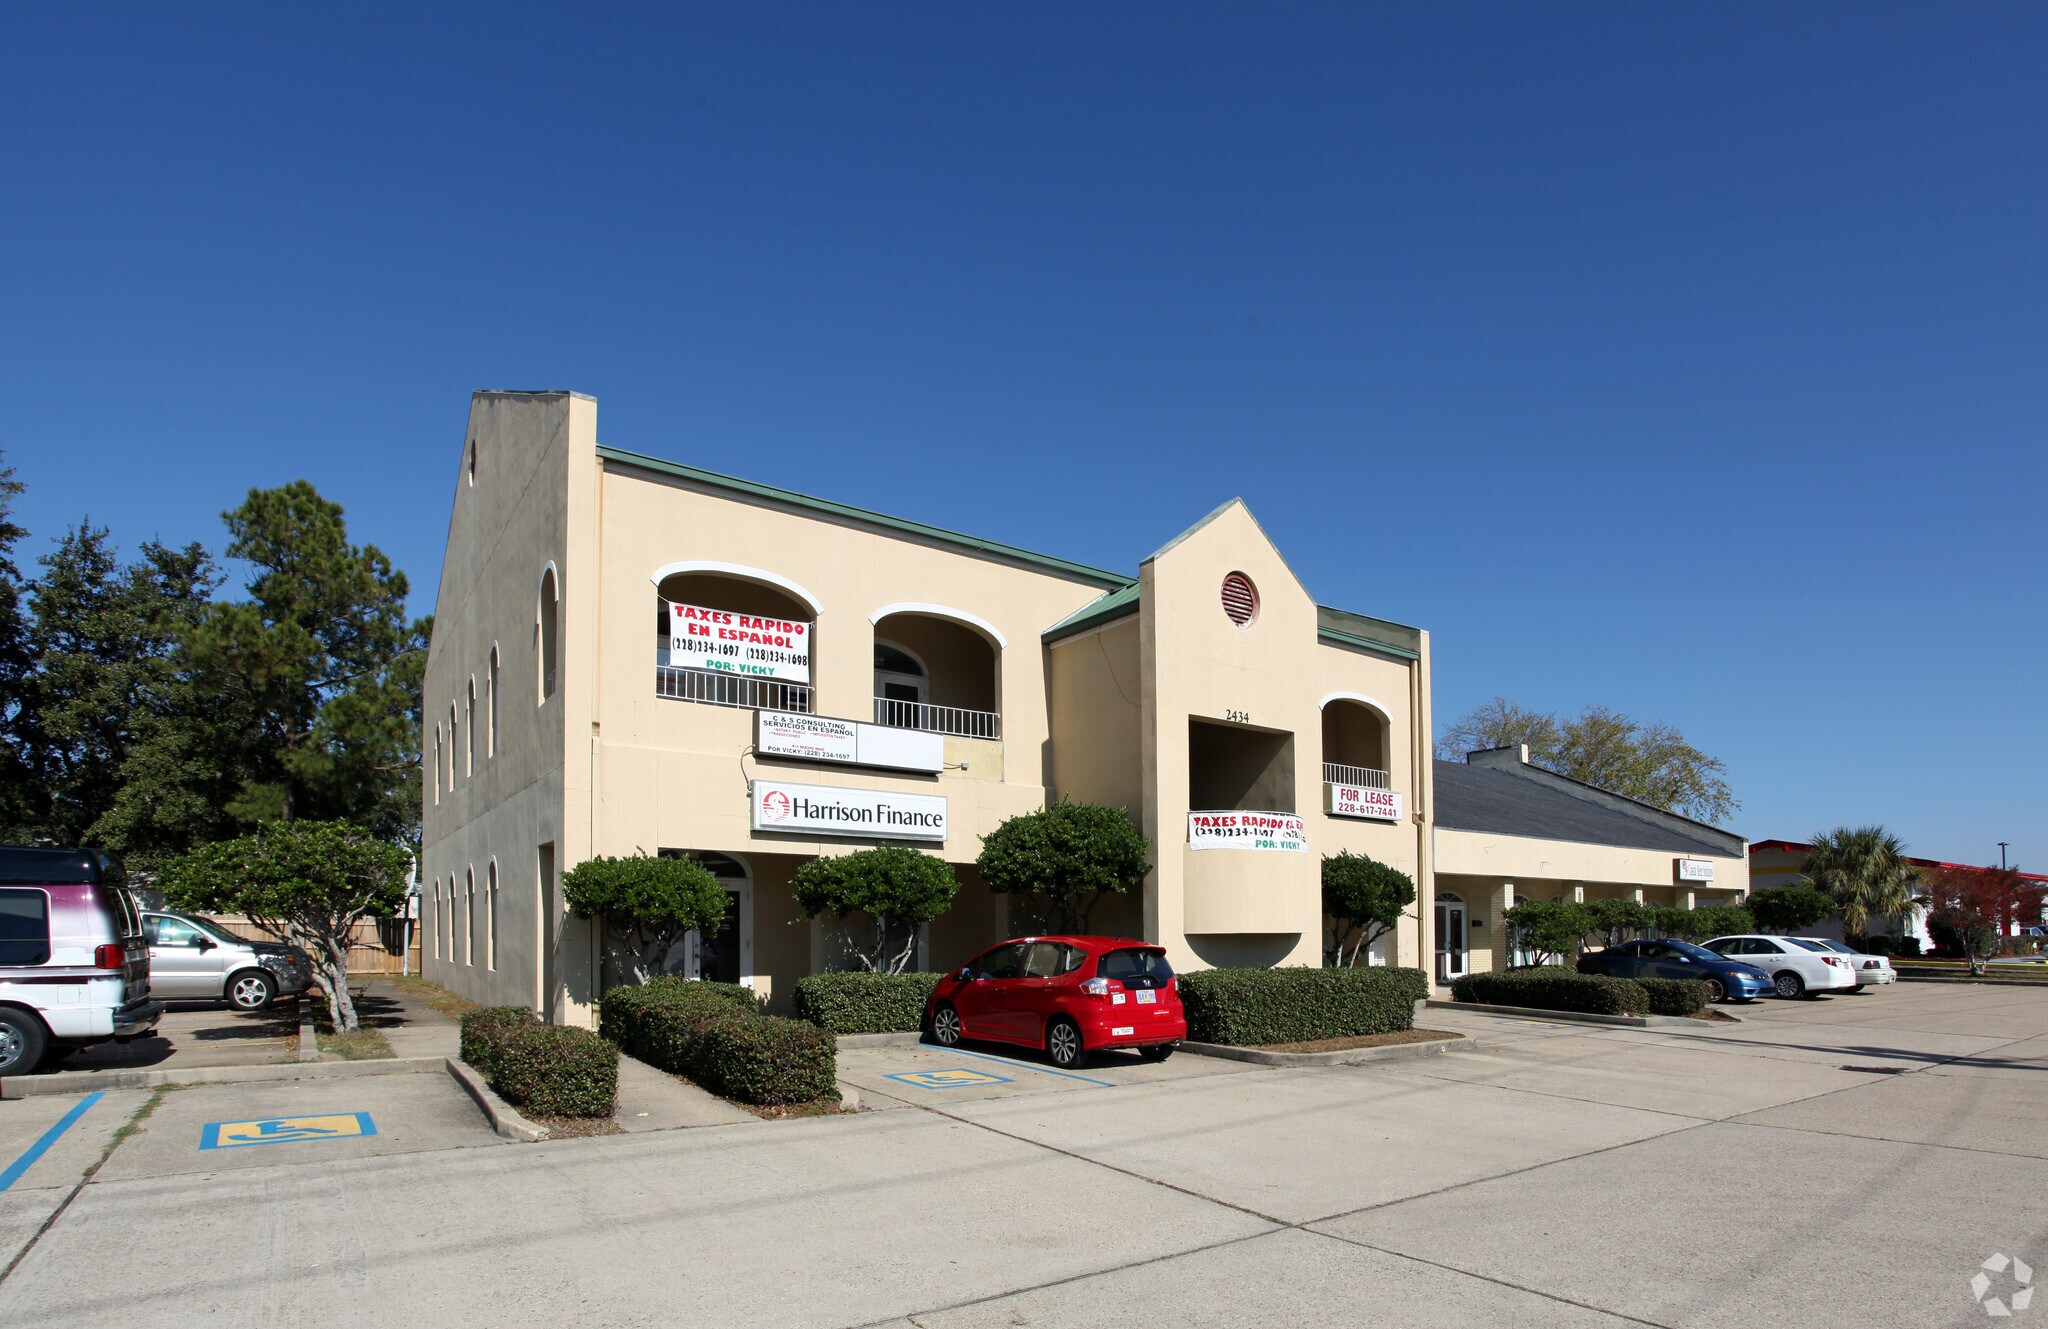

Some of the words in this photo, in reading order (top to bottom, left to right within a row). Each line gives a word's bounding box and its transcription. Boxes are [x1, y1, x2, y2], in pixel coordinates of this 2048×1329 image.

[675, 606, 732, 625] TAXES
[739, 616, 805, 635] RAPIDO
[688, 623, 710, 636] EN
[718, 628, 793, 648] ESPAÑOL
[672, 636, 739, 657] (228)234-1697
[746, 647, 807, 666] (228)234-1698
[706, 659, 735, 671] POR:
[739, 663, 775, 676] VICKY
[796, 718, 846, 729] CONSULTING
[1226, 709, 1250, 724] 2434
[763, 720, 805, 731] SERVICIOS
[804, 749, 821, 757] (228)
[822, 751, 850, 759] 234-1697
[1340, 788, 1359, 803] FOR
[1365, 791, 1394, 806] LEASE
[793, 797, 872, 823] Harrison
[876, 803, 943, 828] Finance
[1338, 802, 1397, 818] 228-617-7441
[1194, 816, 1237, 827] TAXES
[1241, 816, 1283, 829] RAPIDO
[1255, 839, 1278, 849] POR:
